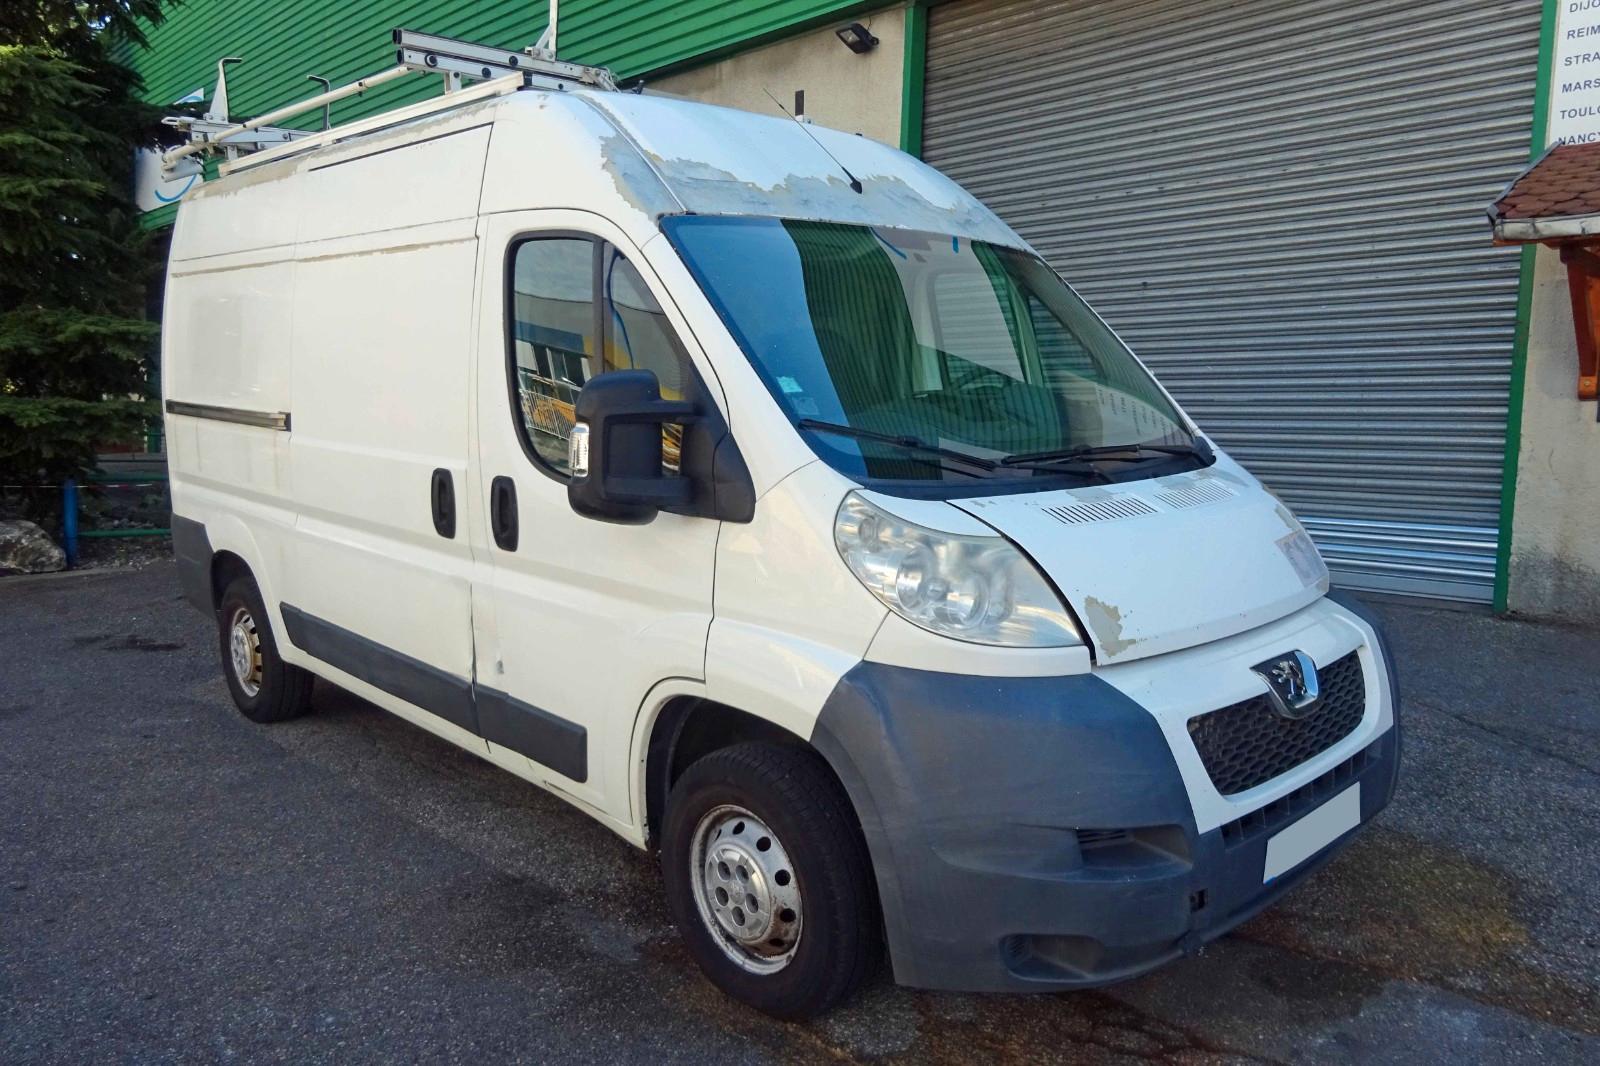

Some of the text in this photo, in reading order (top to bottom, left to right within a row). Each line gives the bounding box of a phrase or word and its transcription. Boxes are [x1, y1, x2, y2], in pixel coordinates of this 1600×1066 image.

[1564, 52, 1600, 66] STRA
[1562, 78, 1600, 94] MARS
[1560, 105, 1600, 120] TOUL
[1558, 132, 1600, 146] NANC
